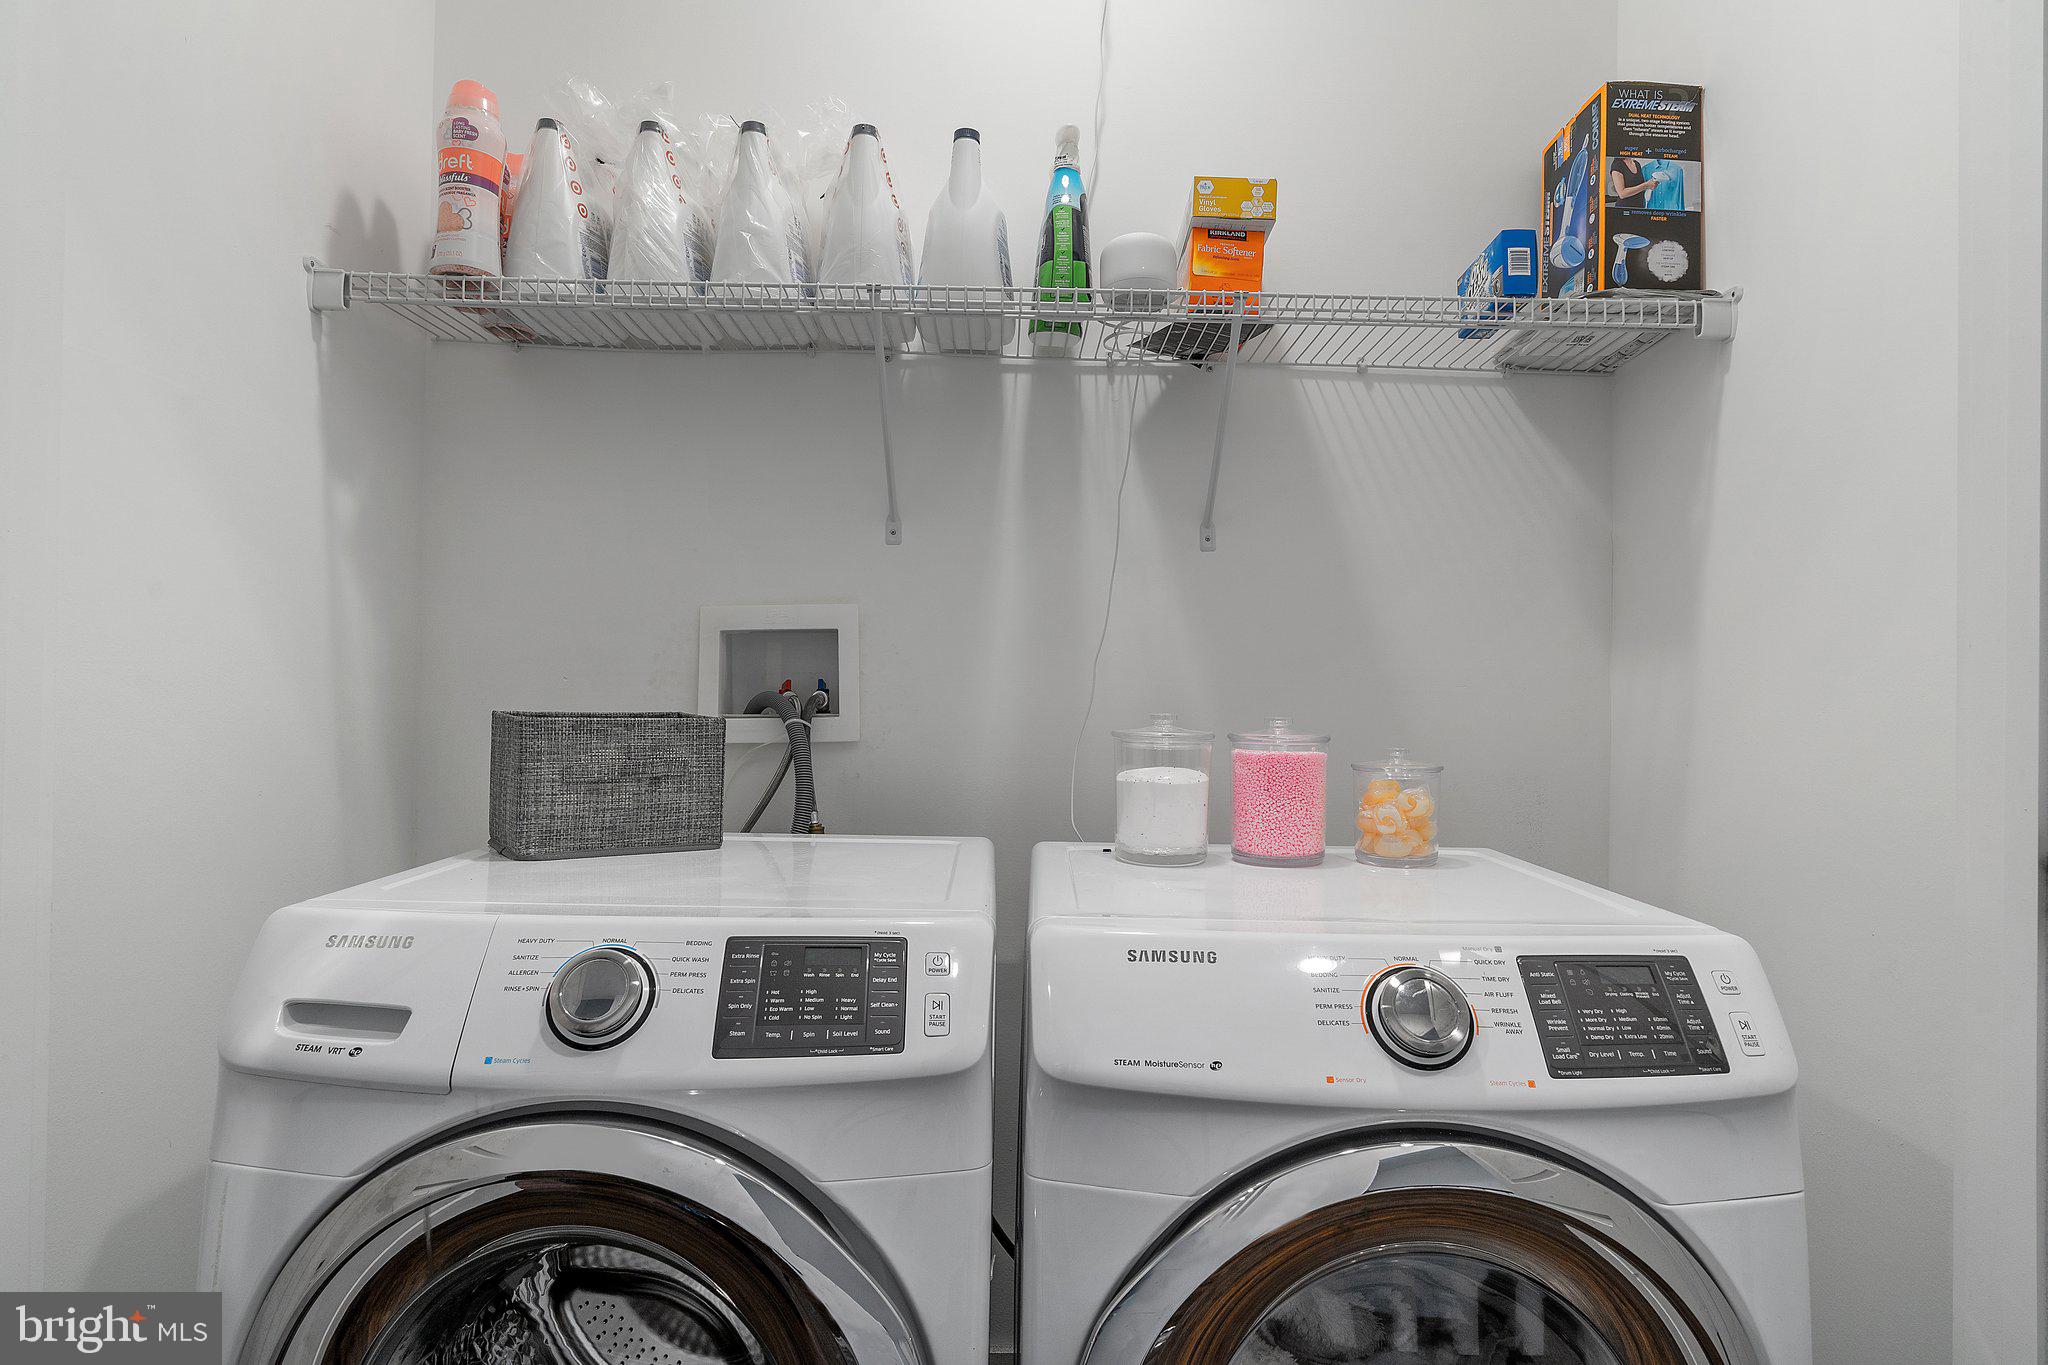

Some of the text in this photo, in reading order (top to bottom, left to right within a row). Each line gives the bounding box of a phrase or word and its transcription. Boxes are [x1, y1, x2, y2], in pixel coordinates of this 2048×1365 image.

[1618, 88, 1663, 100] WHAT IS
[1199, 198, 1216, 206] Vinyl
[1209, 230, 1246, 238] KIRKLAND
[1198, 244, 1220, 254] Fabric
[1222, 246, 1256, 258] Softener
[325, 934, 415, 949] SAMSUNG
[1127, 949, 1218, 964] SAMSUNG
[766, 1031, 782, 1039] Temp.
[295, 1044, 322, 1053] STEAM
[1114, 1058, 1140, 1066] STEAM
[1144, 1060, 1205, 1069] MoistureSensor
